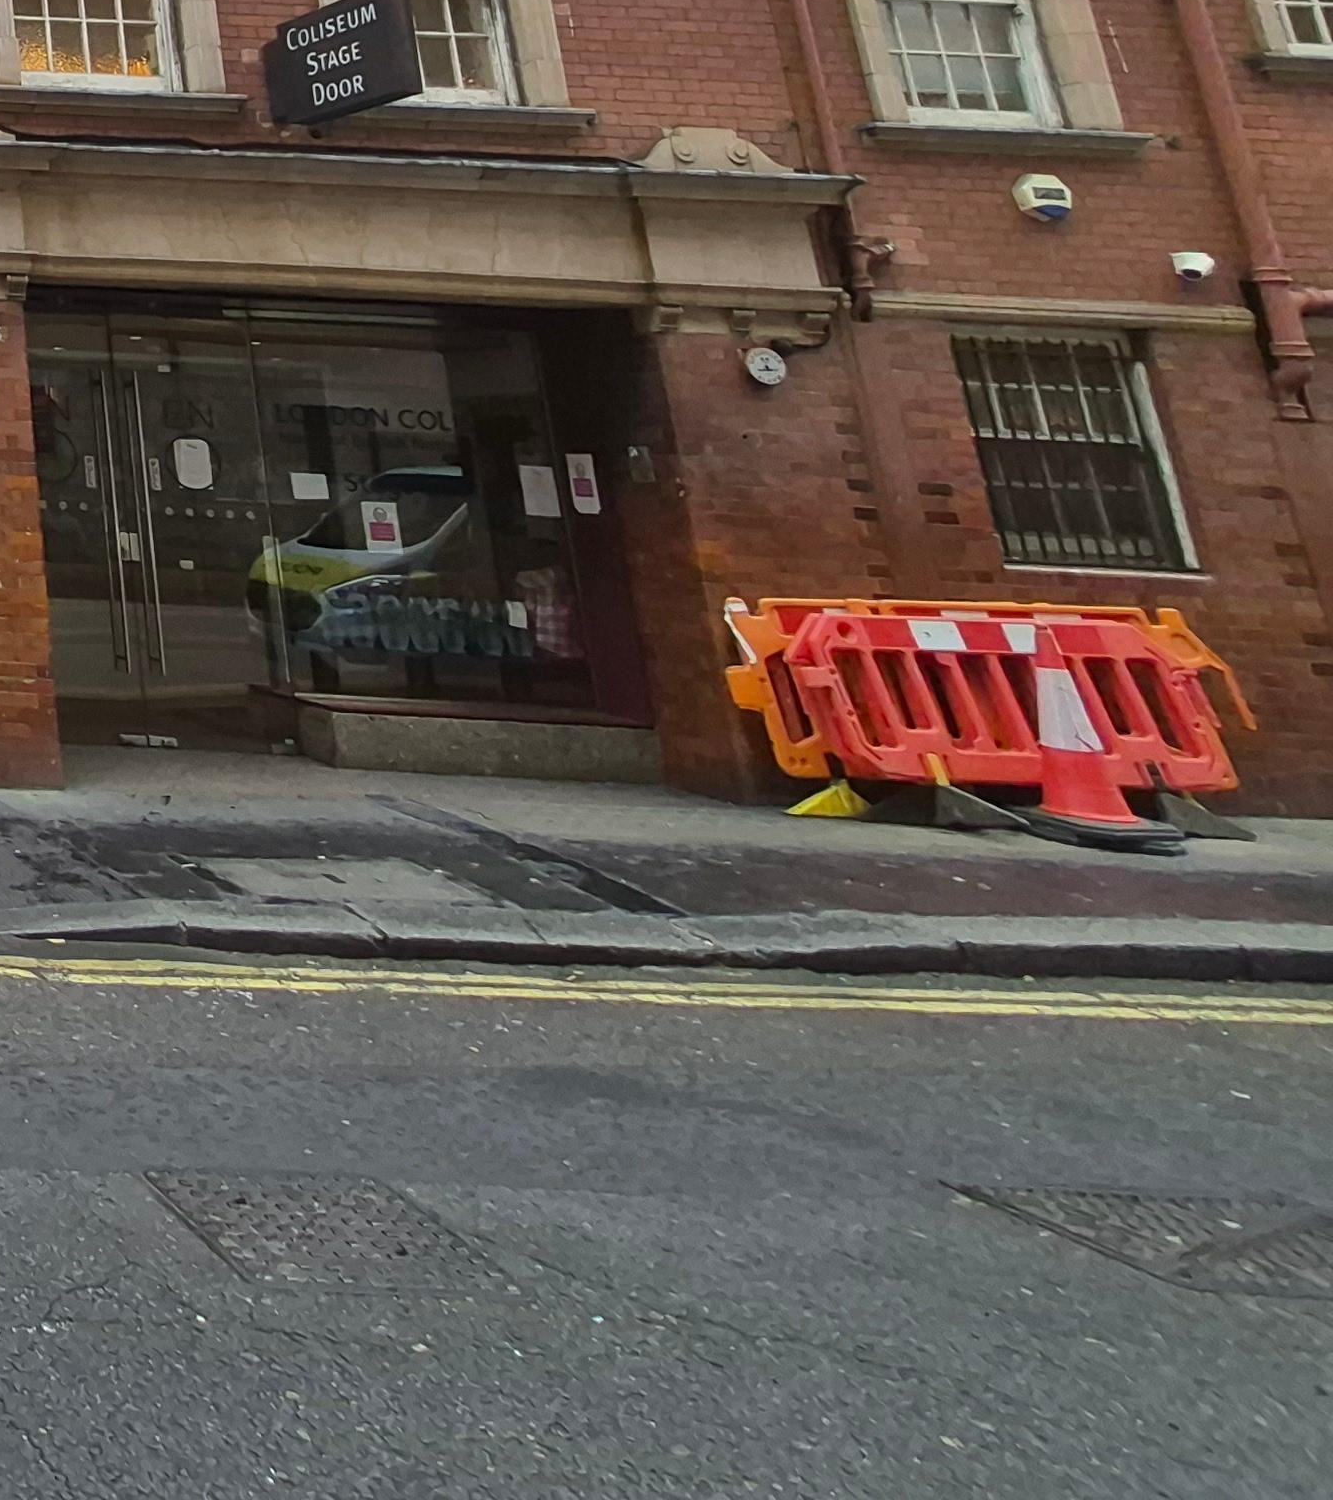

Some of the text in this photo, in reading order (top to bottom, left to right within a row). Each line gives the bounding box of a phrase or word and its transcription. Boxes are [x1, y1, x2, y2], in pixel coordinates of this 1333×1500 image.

[286, 3, 377, 51] COLISEUM
[306, 41, 362, 76] STAGE
[312, 74, 365, 106] DOOR
